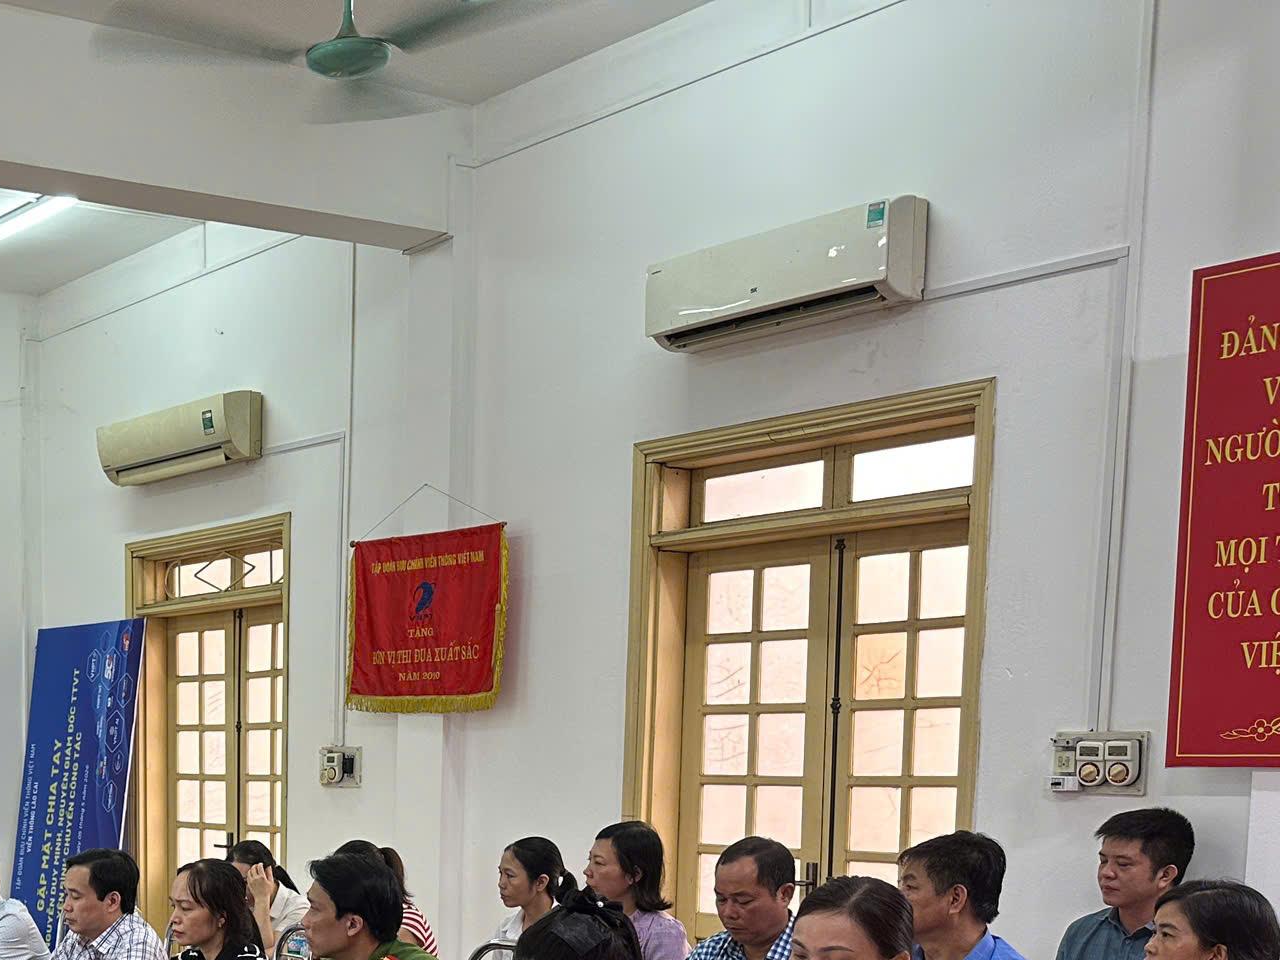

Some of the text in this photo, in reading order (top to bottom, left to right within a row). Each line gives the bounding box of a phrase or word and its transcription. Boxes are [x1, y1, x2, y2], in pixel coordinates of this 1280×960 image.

[1220, 314, 1280, 360] ĐẢN
[1204, 417, 1280, 466] NGƯỜ
[1214, 536, 1268, 574] MỌI
[1207, 578, 1263, 619] CỦA
[396, 649, 412, 664] THI
[414, 648, 433, 663] ĐUA
[434, 640, 460, 661] XUẤT
[461, 636, 480, 660] SẮC
[1240, 631, 1280, 675] VIỆ
[71, 668, 80, 703] TTVT
[67, 706, 76, 733] ĐỐC
[63, 736, 73, 769] GIÁM
[73, 732, 82, 760] TÁC
[57, 772, 69, 826] NGUYÊN
[69, 761, 79, 799] CÔNG
[37, 739, 62, 911] GẶP MẶT CHIA TAY
[63, 801, 75, 855] CHUYỂN
[50, 868, 58, 895] DUY
